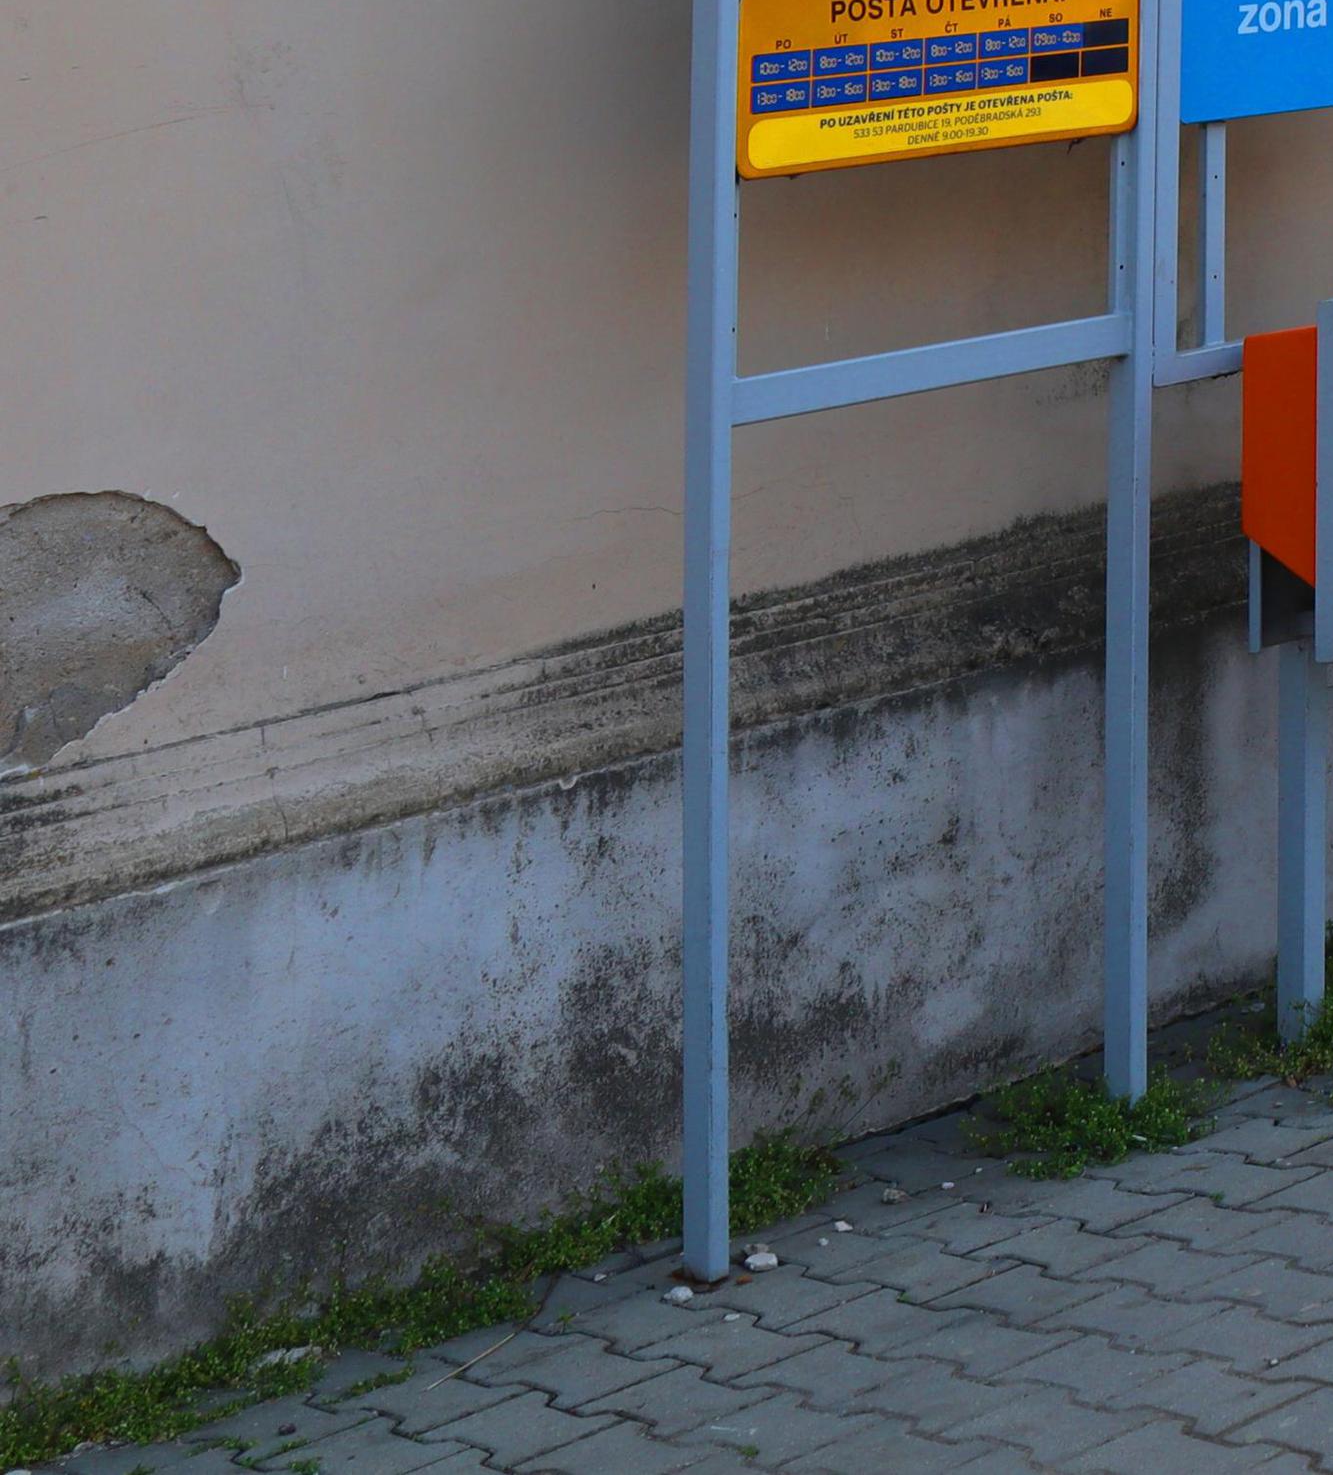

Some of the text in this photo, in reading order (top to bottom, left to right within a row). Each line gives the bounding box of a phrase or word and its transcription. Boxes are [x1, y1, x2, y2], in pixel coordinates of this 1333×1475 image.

[775, 39, 791, 50] PO
[890, 28, 903, 39] ST
[944, 21, 958, 33] ČT
[1049, 13, 1063, 23] SO
[1099, 8, 1112, 18] NE
[820, 118, 836, 129] PO
[838, 107, 895, 128] UZAVŘENÍ
[897, 104, 925, 120] TÉTO
[927, 101, 961, 117] POŠTY
[964, 100, 978, 112] JE
[978, 92, 1035, 110] OTEVŘENA
[885, 119, 939, 136] PARDUBICE
[954, 108, 1024, 127] PODĚBRADSKÁ
[1025, 107, 1042, 118] 293
[907, 130, 940, 146] DENNĚ
